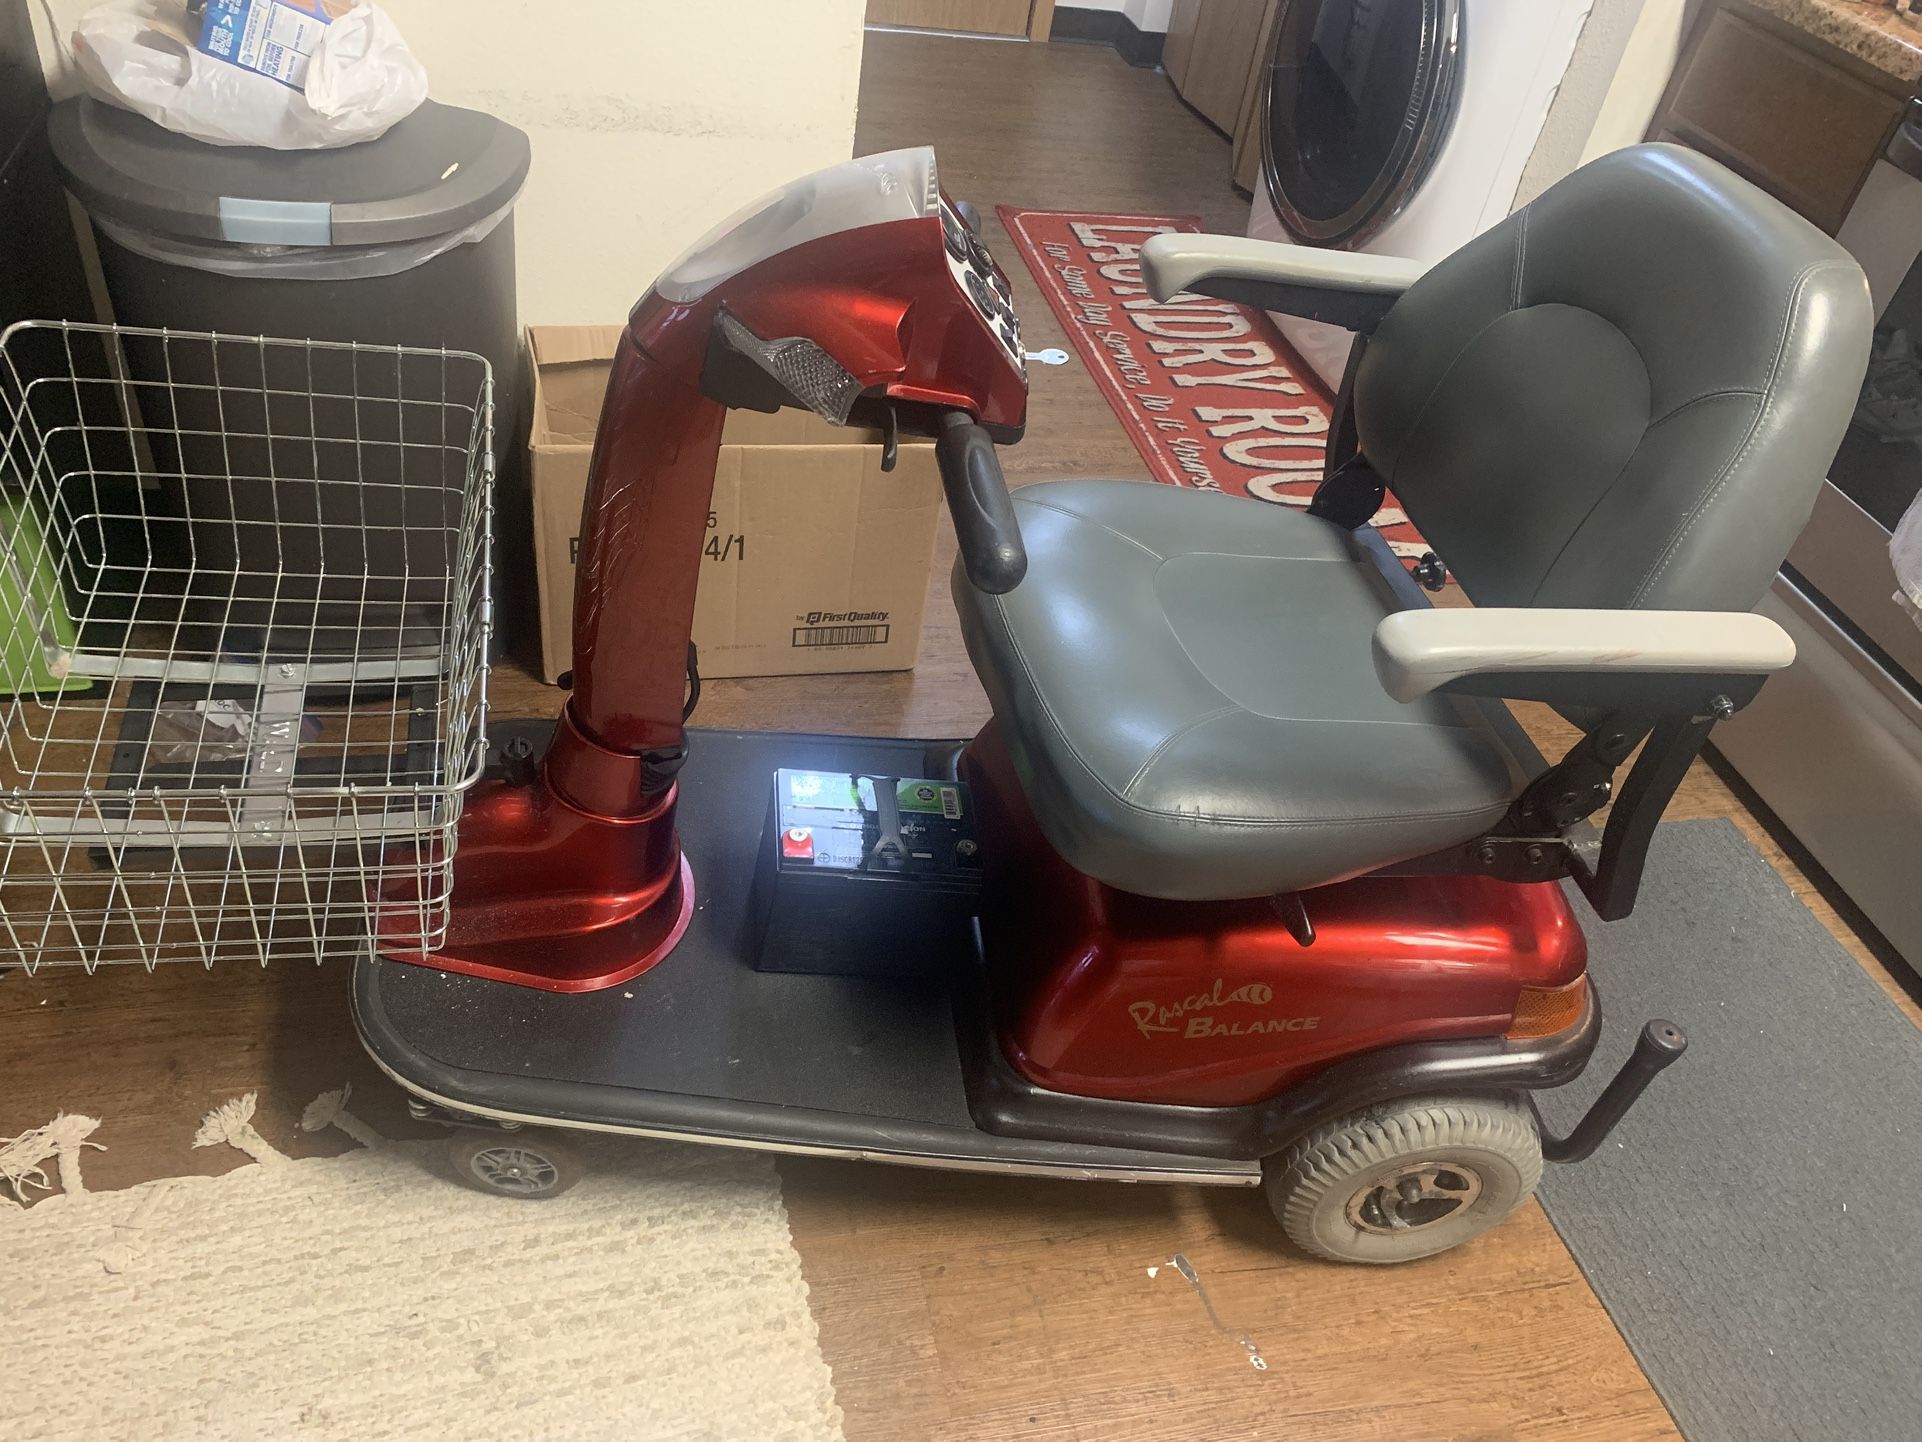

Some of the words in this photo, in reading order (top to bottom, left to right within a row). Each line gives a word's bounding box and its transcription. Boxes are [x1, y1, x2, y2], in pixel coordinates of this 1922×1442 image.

[269, 45, 284, 76] HEATING
[1054, 264, 1095, 298] Same
[1076, 301, 1112, 326] Day
[1135, 393, 1174, 412] Do
[705, 534, 745, 562] 4/1
[1128, 978, 1226, 1040] Rascal
